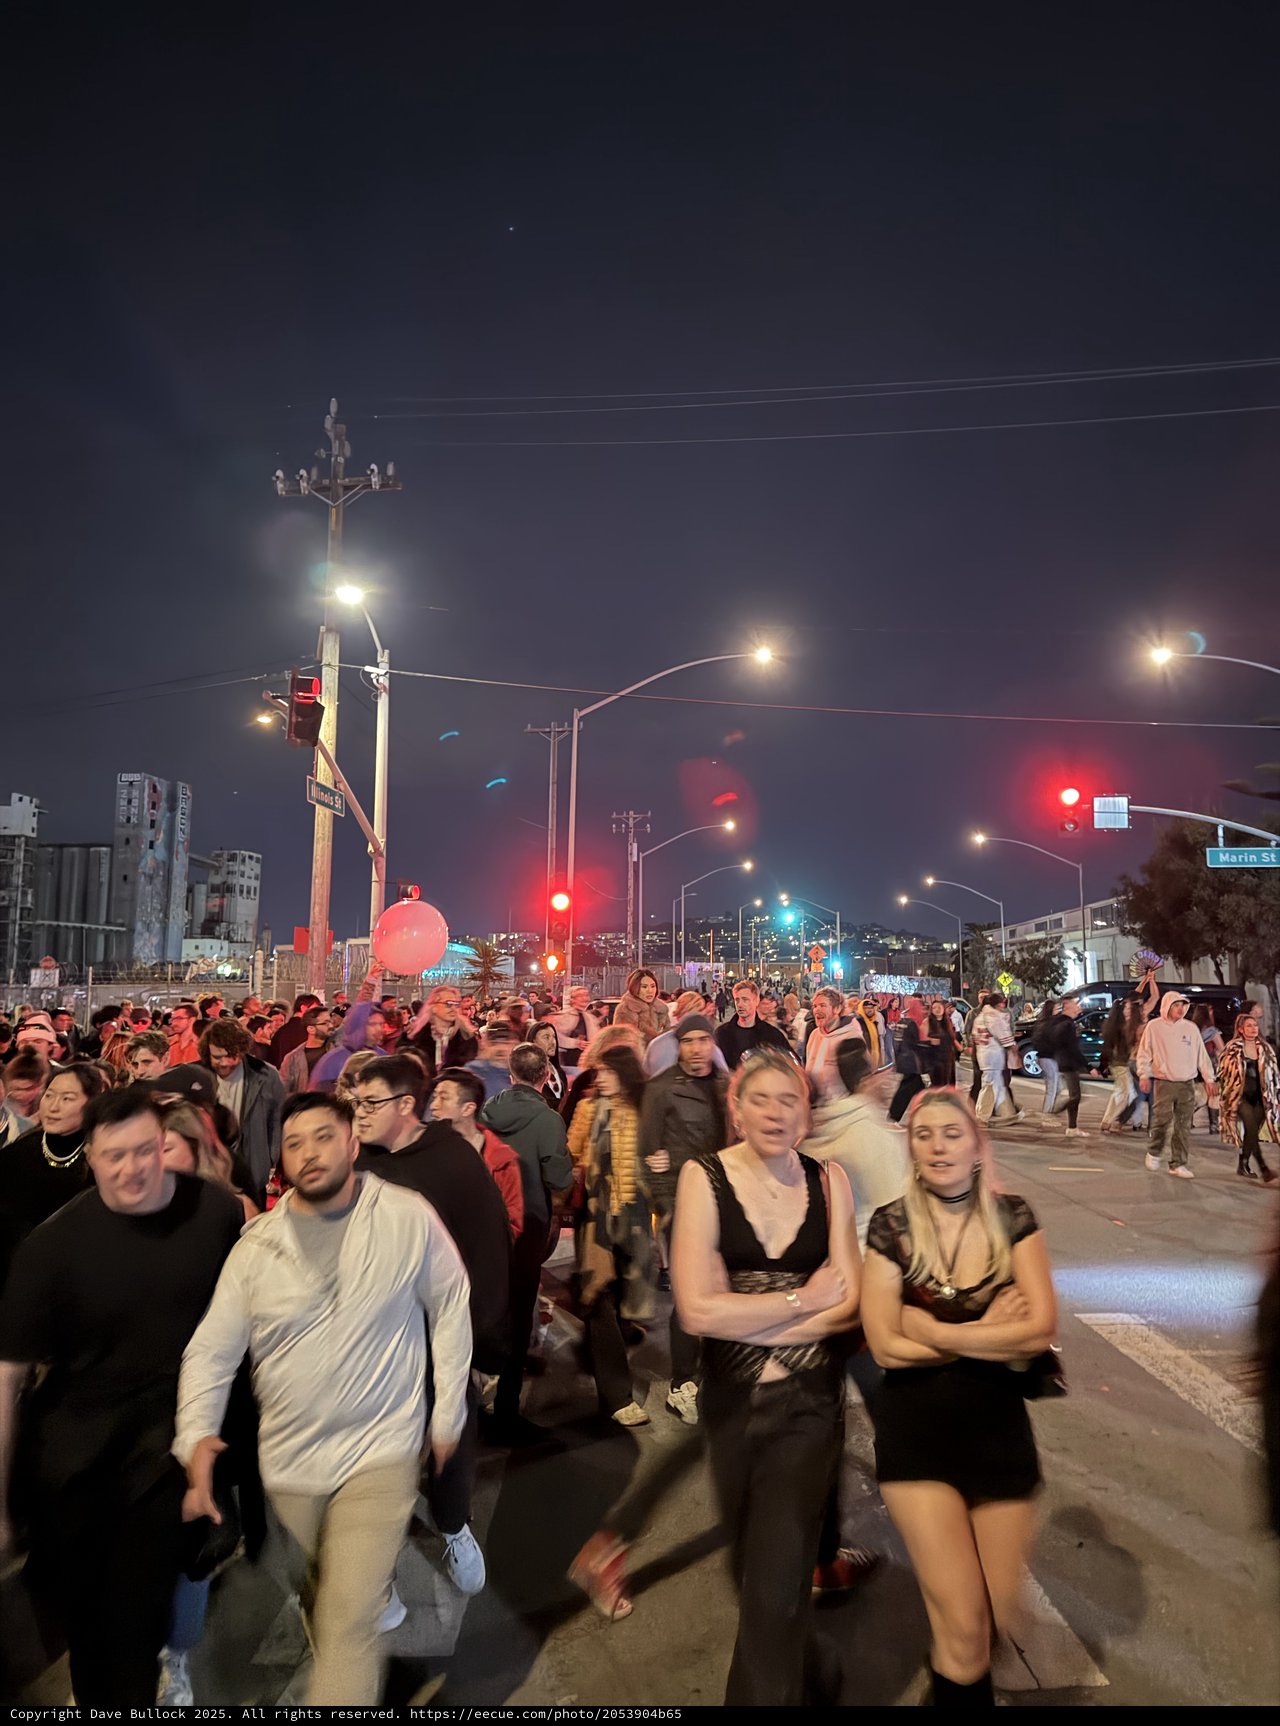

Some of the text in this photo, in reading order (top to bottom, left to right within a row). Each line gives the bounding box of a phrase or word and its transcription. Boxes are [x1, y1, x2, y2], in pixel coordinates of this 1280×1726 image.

[311, 783, 342, 809] Illinois St
[1219, 852, 1276, 863] Marin St
